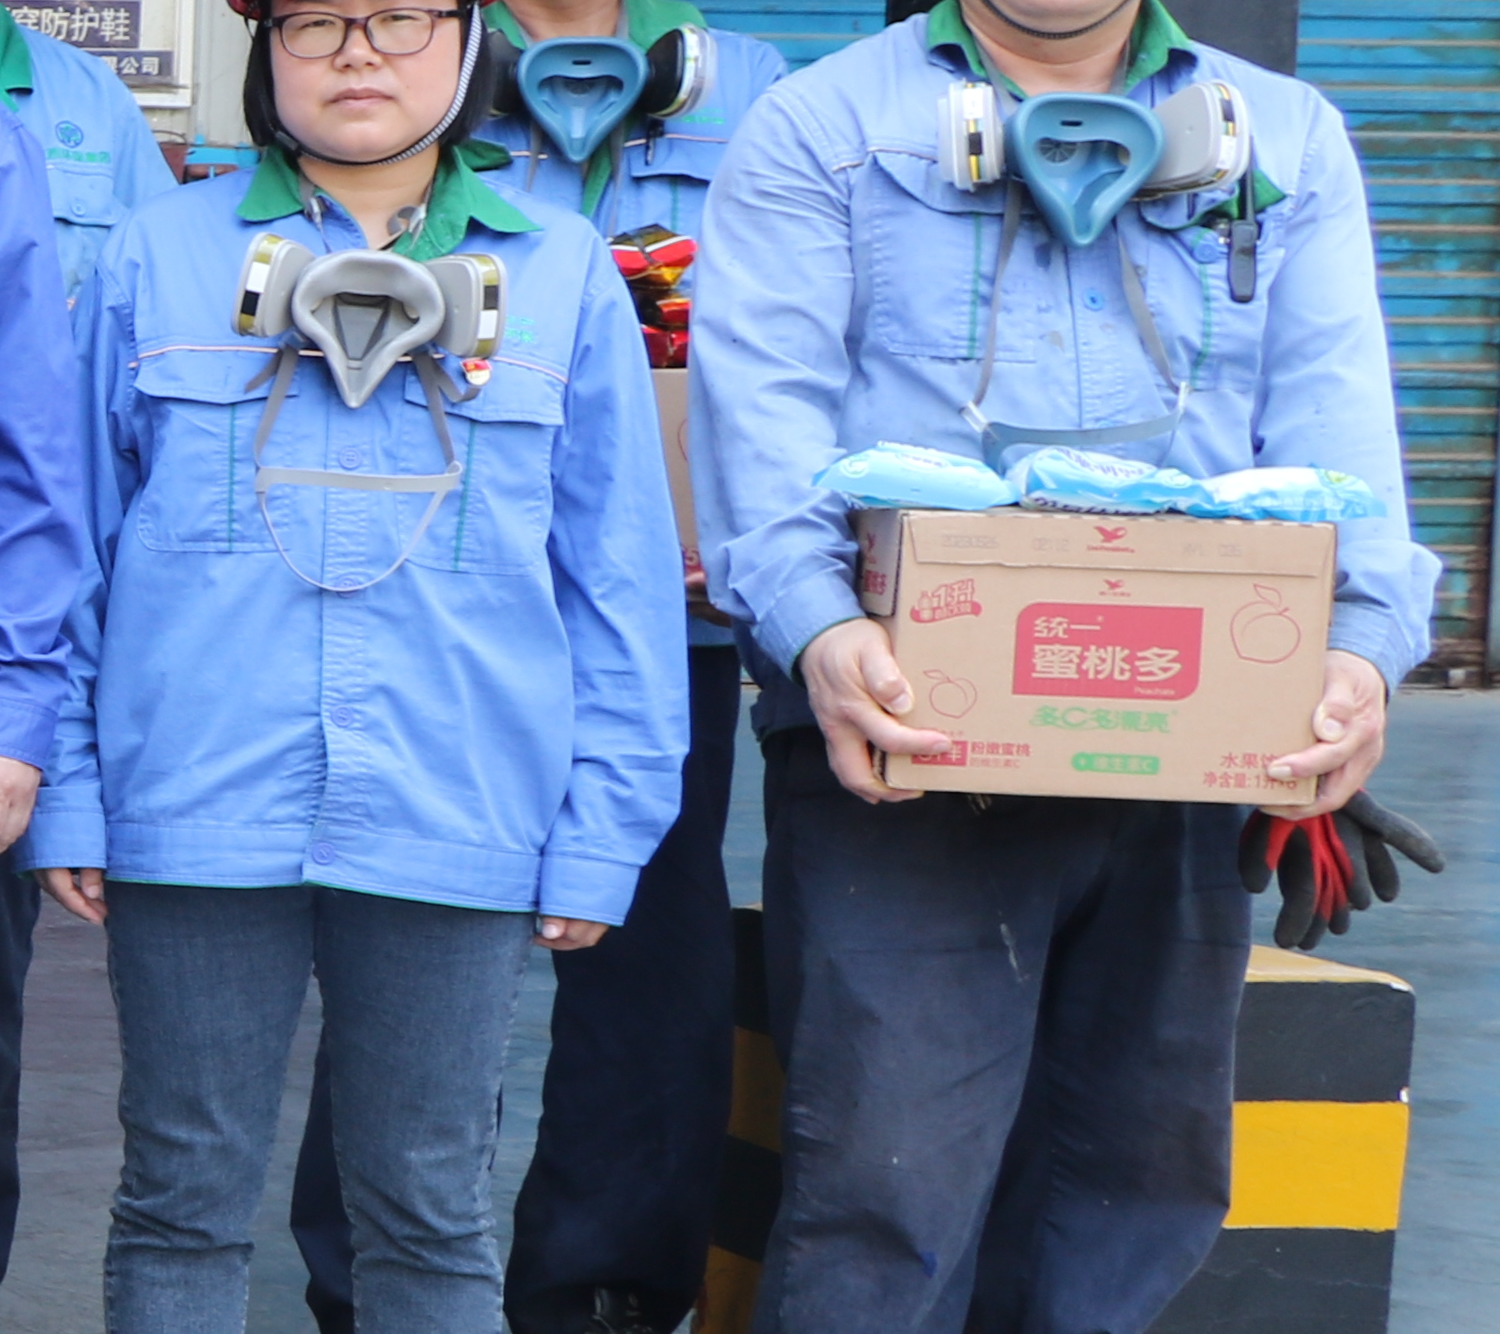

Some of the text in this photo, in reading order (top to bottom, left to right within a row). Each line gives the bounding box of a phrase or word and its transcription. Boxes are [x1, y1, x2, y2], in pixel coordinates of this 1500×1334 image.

[1033, 616, 1101, 638] 统一
[1031, 644, 1182, 682] 蜜桃多
